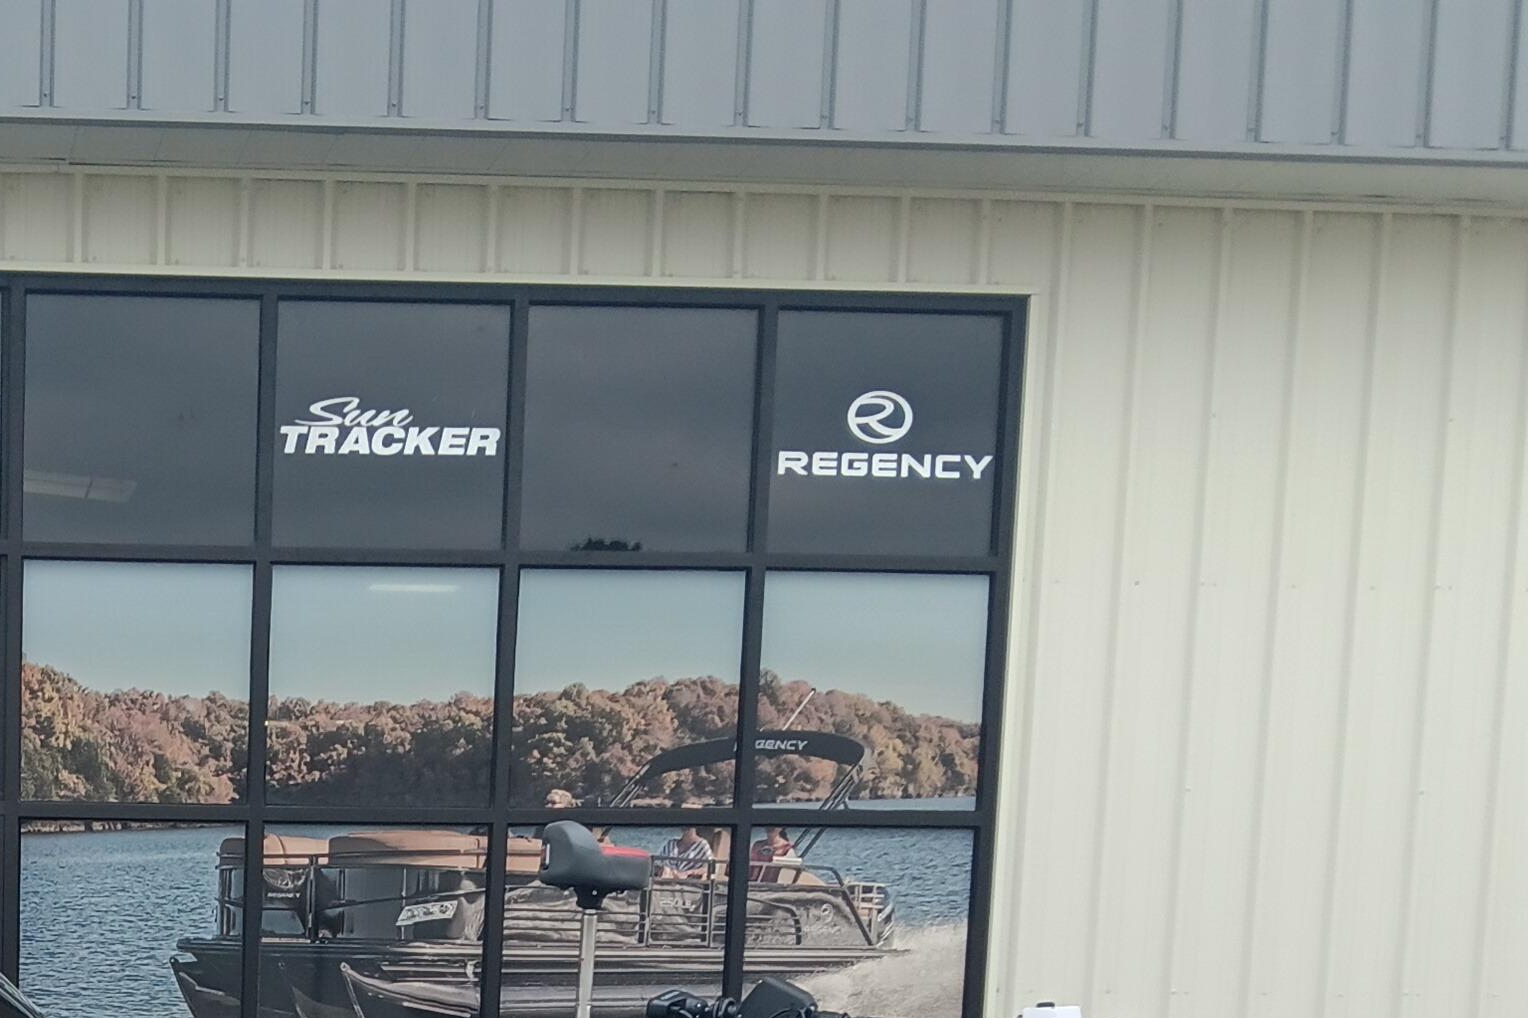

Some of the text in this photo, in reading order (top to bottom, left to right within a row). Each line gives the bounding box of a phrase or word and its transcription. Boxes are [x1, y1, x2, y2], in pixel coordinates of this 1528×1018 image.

[294, 396, 414, 428] Sun
[279, 425, 502, 456] TRACKER
[776, 450, 994, 480] REGENCY
[733, 739, 808, 751] GENCY
